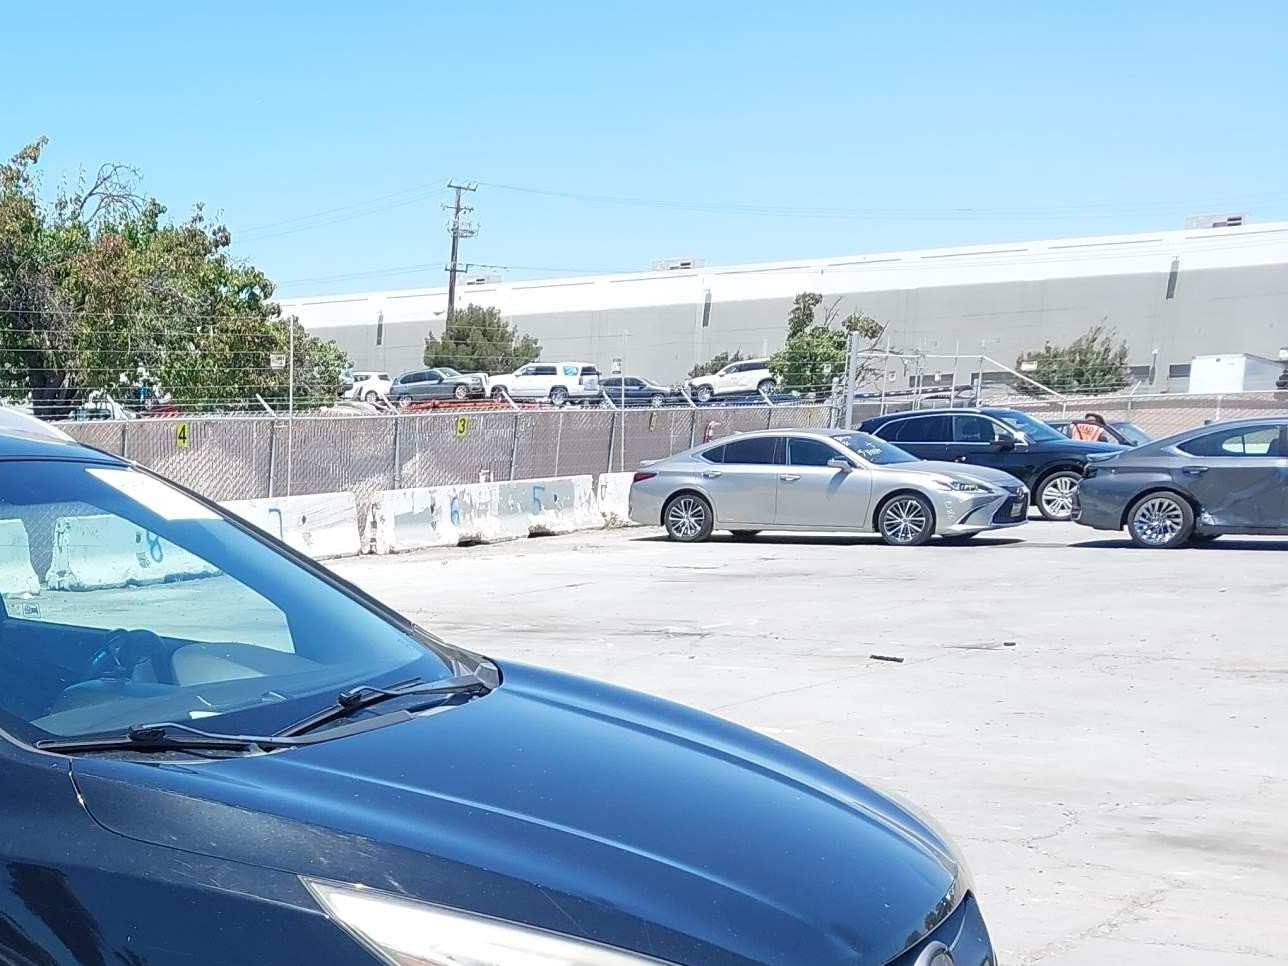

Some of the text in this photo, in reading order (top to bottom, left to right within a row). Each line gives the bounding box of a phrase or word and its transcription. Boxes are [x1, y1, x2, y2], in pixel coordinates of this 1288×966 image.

[178, 424, 187, 443] 4
[458, 418, 466, 434] 3
[268, 507, 283, 541] 7
[450, 495, 461, 526] 6
[146, 529, 163, 563] 8
